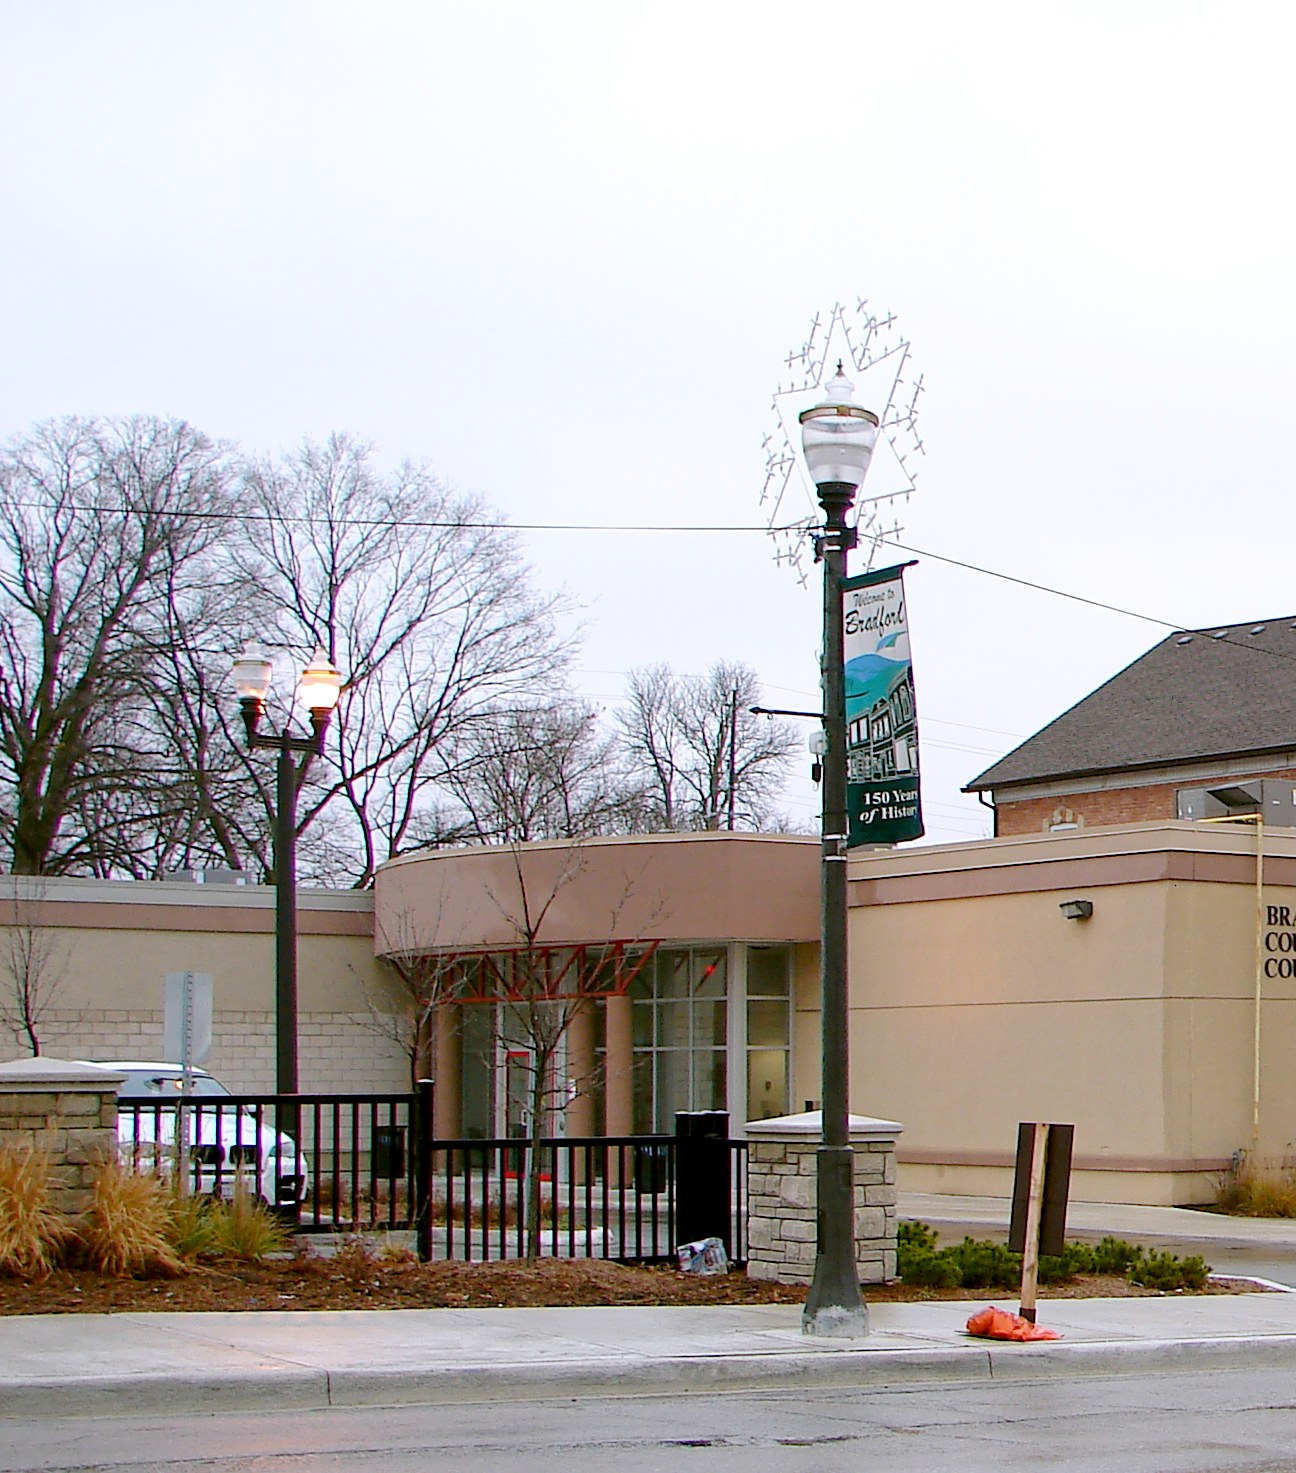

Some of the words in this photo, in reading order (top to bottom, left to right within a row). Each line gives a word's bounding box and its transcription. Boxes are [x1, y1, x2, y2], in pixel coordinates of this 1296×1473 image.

[845, 601, 904, 637] Bradford
[864, 791, 890, 805] 150
[860, 808, 880, 824] of
